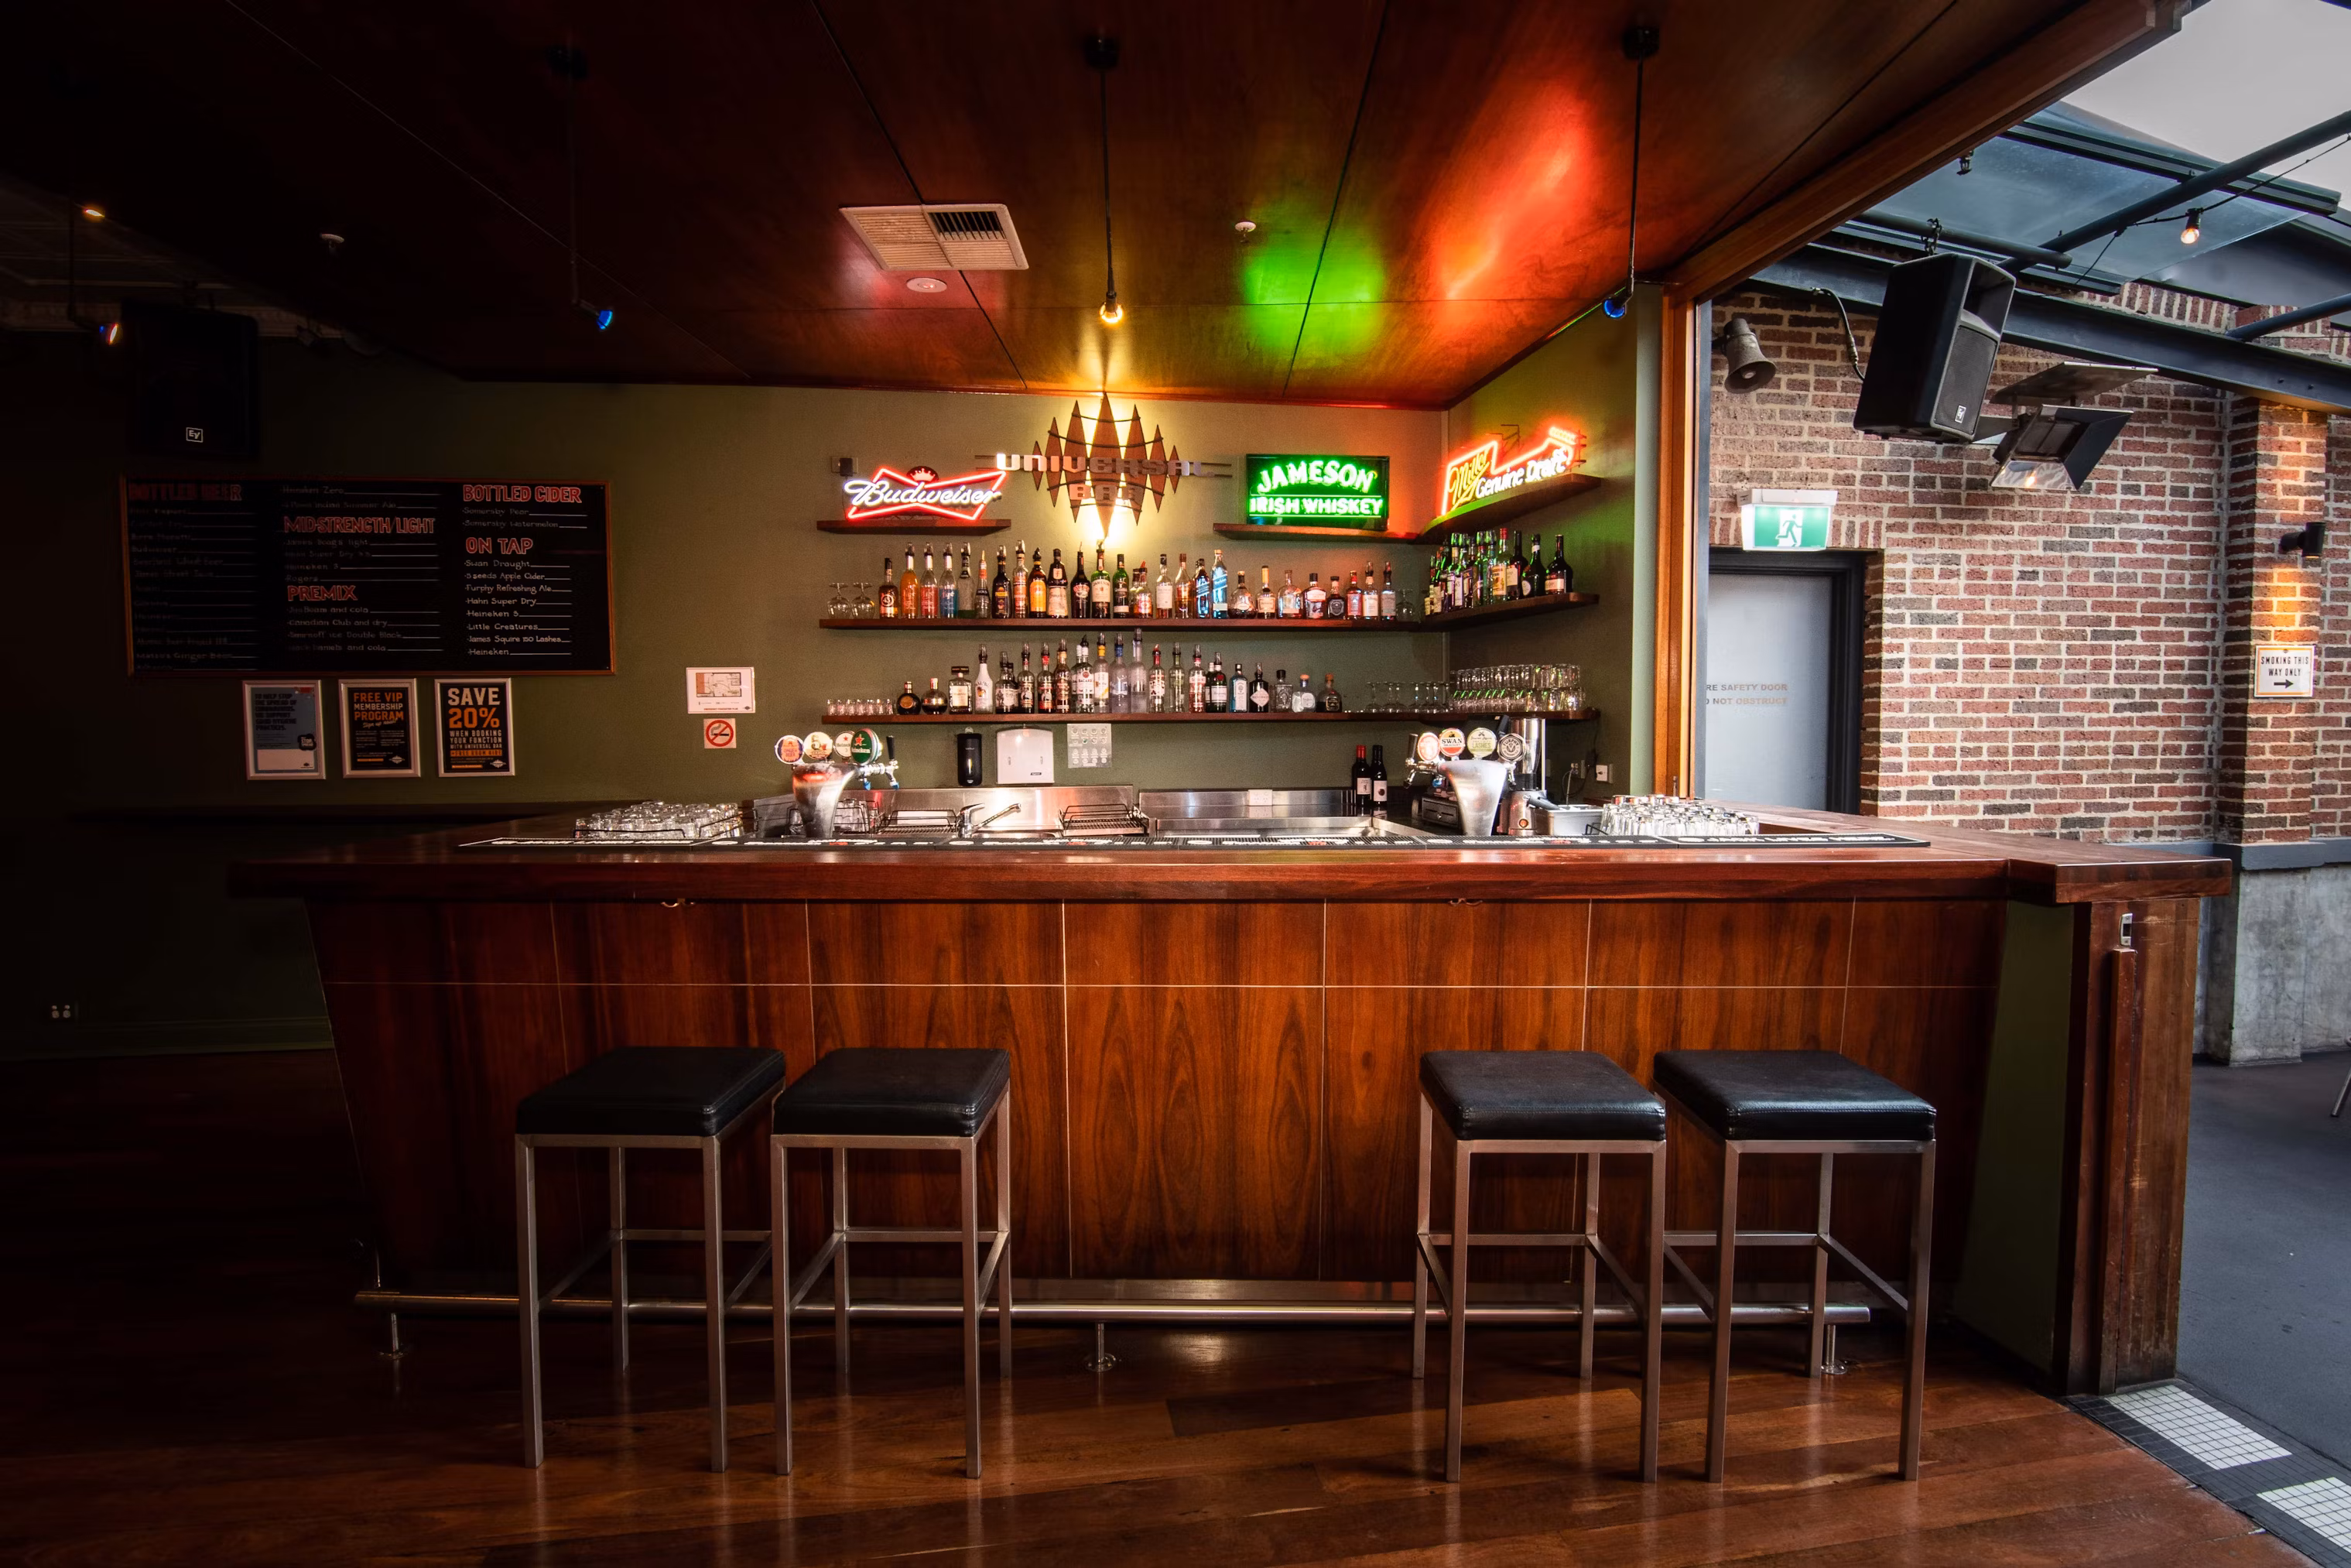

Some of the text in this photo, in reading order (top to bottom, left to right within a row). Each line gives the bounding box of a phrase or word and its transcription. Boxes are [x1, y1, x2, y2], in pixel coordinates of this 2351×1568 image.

[996, 453, 1216, 478] UNIVERSAL
[1476, 446, 1567, 499] Genuine Draft
[1257, 460, 1378, 493] JAMESON
[1448, 448, 1490, 506] Miller
[463, 484, 582, 503] BOTTLED CIDER
[844, 479, 1002, 506] Budweiser
[1069, 484, 1144, 503] BAR
[1249, 497, 1383, 515] IRISH WHISKEY
[465, 537, 534, 555] ON TAP
[493, 560, 530, 570] Draught
[500, 573, 522, 581] Apple
[287, 584, 358, 601] PREMIX
[466, 584, 494, 594] Furphy
[496, 584, 538, 595] Refreshing
[491, 597, 518, 607] Super
[521, 597, 537, 607] Dry
[371, 618, 388, 628] dry
[494, 635, 521, 645] Squire
[353, 692, 403, 702] FREE VIP
[448, 687, 501, 706] SAVE
[354, 711, 404, 721] PROGRAM
[448, 707, 500, 728] 20%
